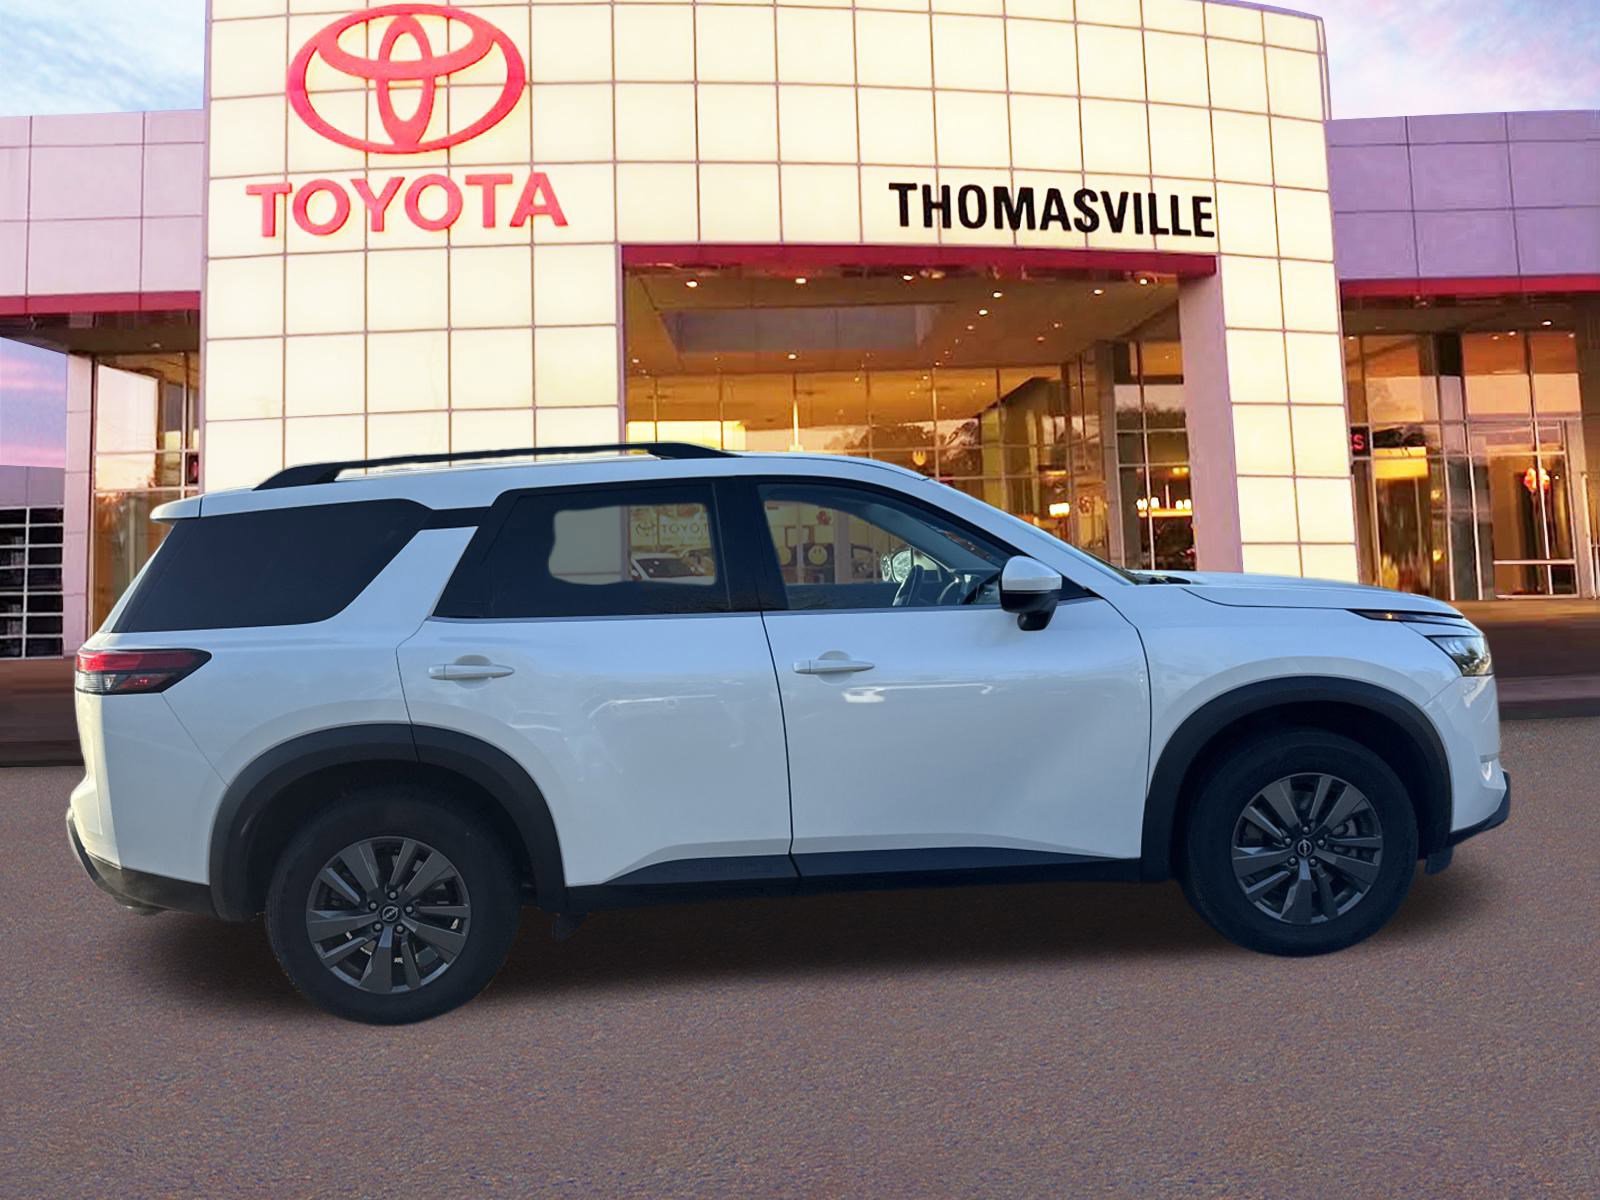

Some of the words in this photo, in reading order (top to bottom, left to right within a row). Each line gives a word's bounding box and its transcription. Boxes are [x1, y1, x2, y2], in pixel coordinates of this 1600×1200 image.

[247, 172, 568, 238] TOYOTA
[889, 182, 1216, 239] THOMASVILLE
[1350, 434, 1365, 450] S
